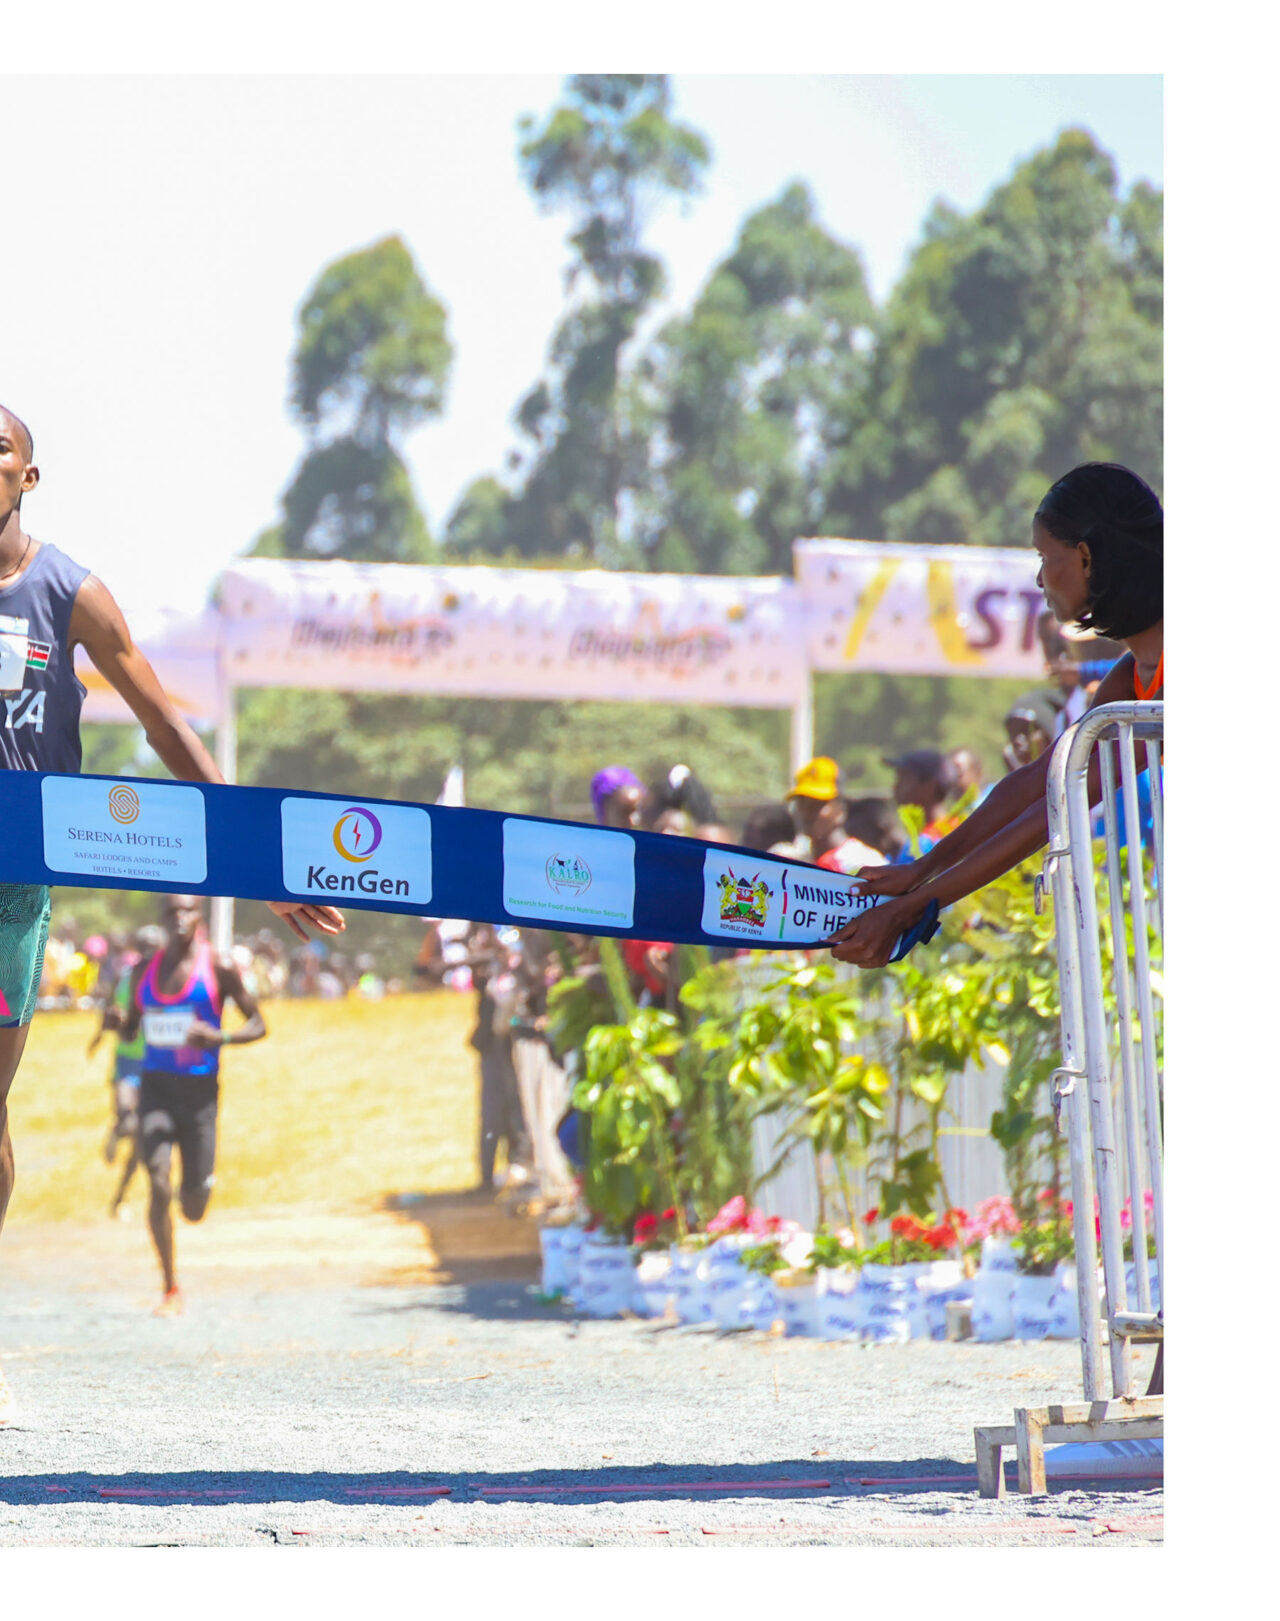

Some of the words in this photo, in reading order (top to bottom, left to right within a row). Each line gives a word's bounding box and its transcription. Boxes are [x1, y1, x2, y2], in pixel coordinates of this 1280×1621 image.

[67, 827, 123, 844] SERENA
[126, 832, 183, 848] HOTELS
[73, 852, 100, 860] SAFARI
[102, 854, 132, 862] LODGES
[134, 856, 150, 864] AND
[151, 857, 178, 866] CAMPS
[93, 865, 122, 874] HOTELS
[128, 868, 161, 877] RESORTS
[549, 866, 589, 881] KALRO
[307, 865, 409, 896] KenGen
[508, 897, 536, 906] Research
[548, 902, 563, 910] Food
[794, 884, 880, 909] MINISTRY
[793, 909, 818, 928] OF
[823, 914, 855, 932] HE
